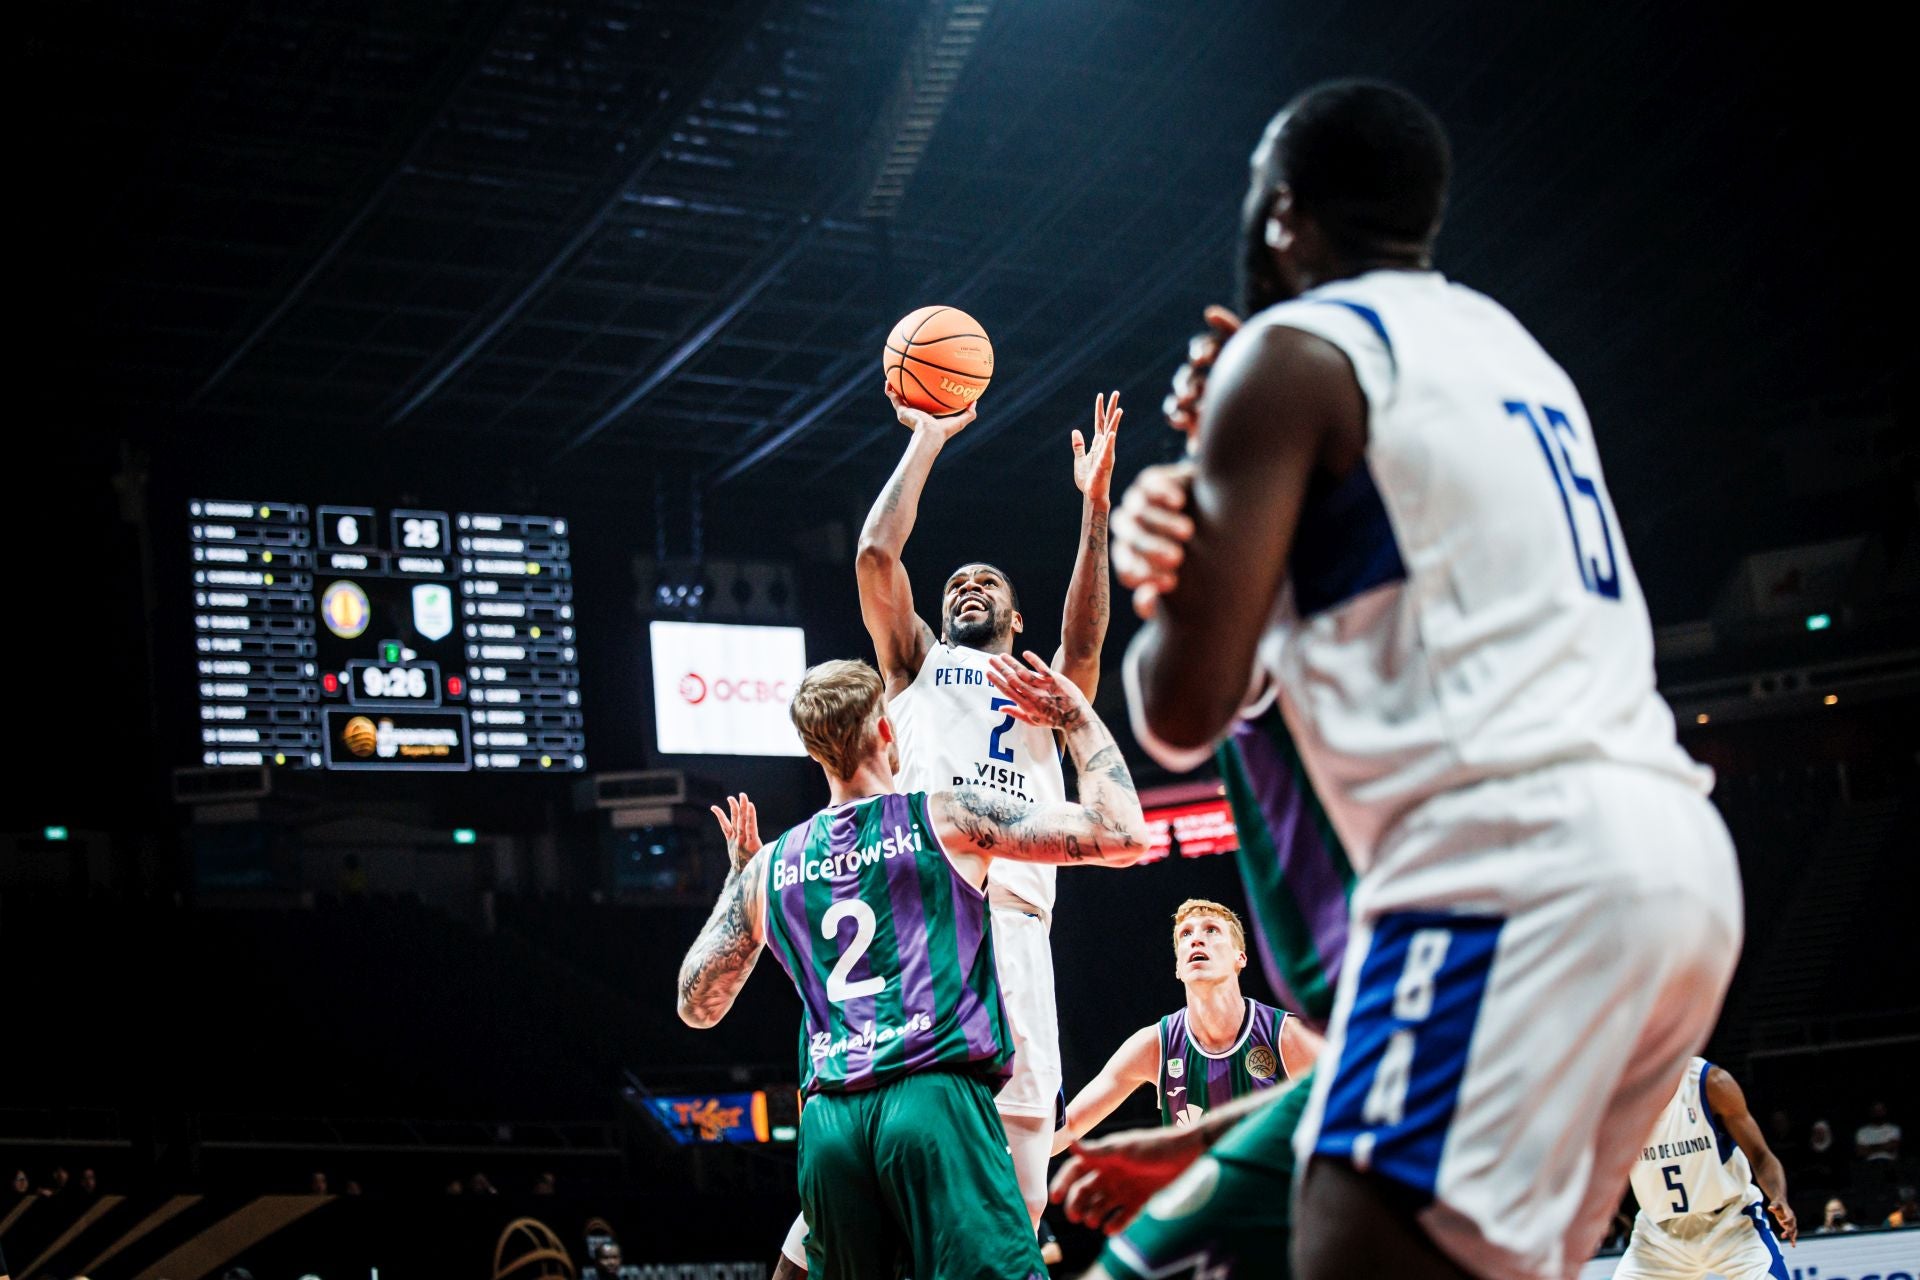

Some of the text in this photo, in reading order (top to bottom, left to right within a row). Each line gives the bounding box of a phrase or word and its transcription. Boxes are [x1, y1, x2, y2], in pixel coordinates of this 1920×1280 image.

[1502, 400, 1620, 599] 15
[337, 516, 359, 545] 6
[403, 518, 440, 548] 25
[363, 666, 427, 698] 9:26
[713, 678, 788, 704] OCBC
[935, 667, 983, 687] PETRO
[988, 696, 1018, 764] 2
[974, 761, 1026, 790] VISIT
[773, 823, 922, 892] Balcerowski
[821, 898, 887, 1002] 2
[1672, 1135, 1712, 1157] LUANDA
[1661, 1164, 1689, 1213] 5
